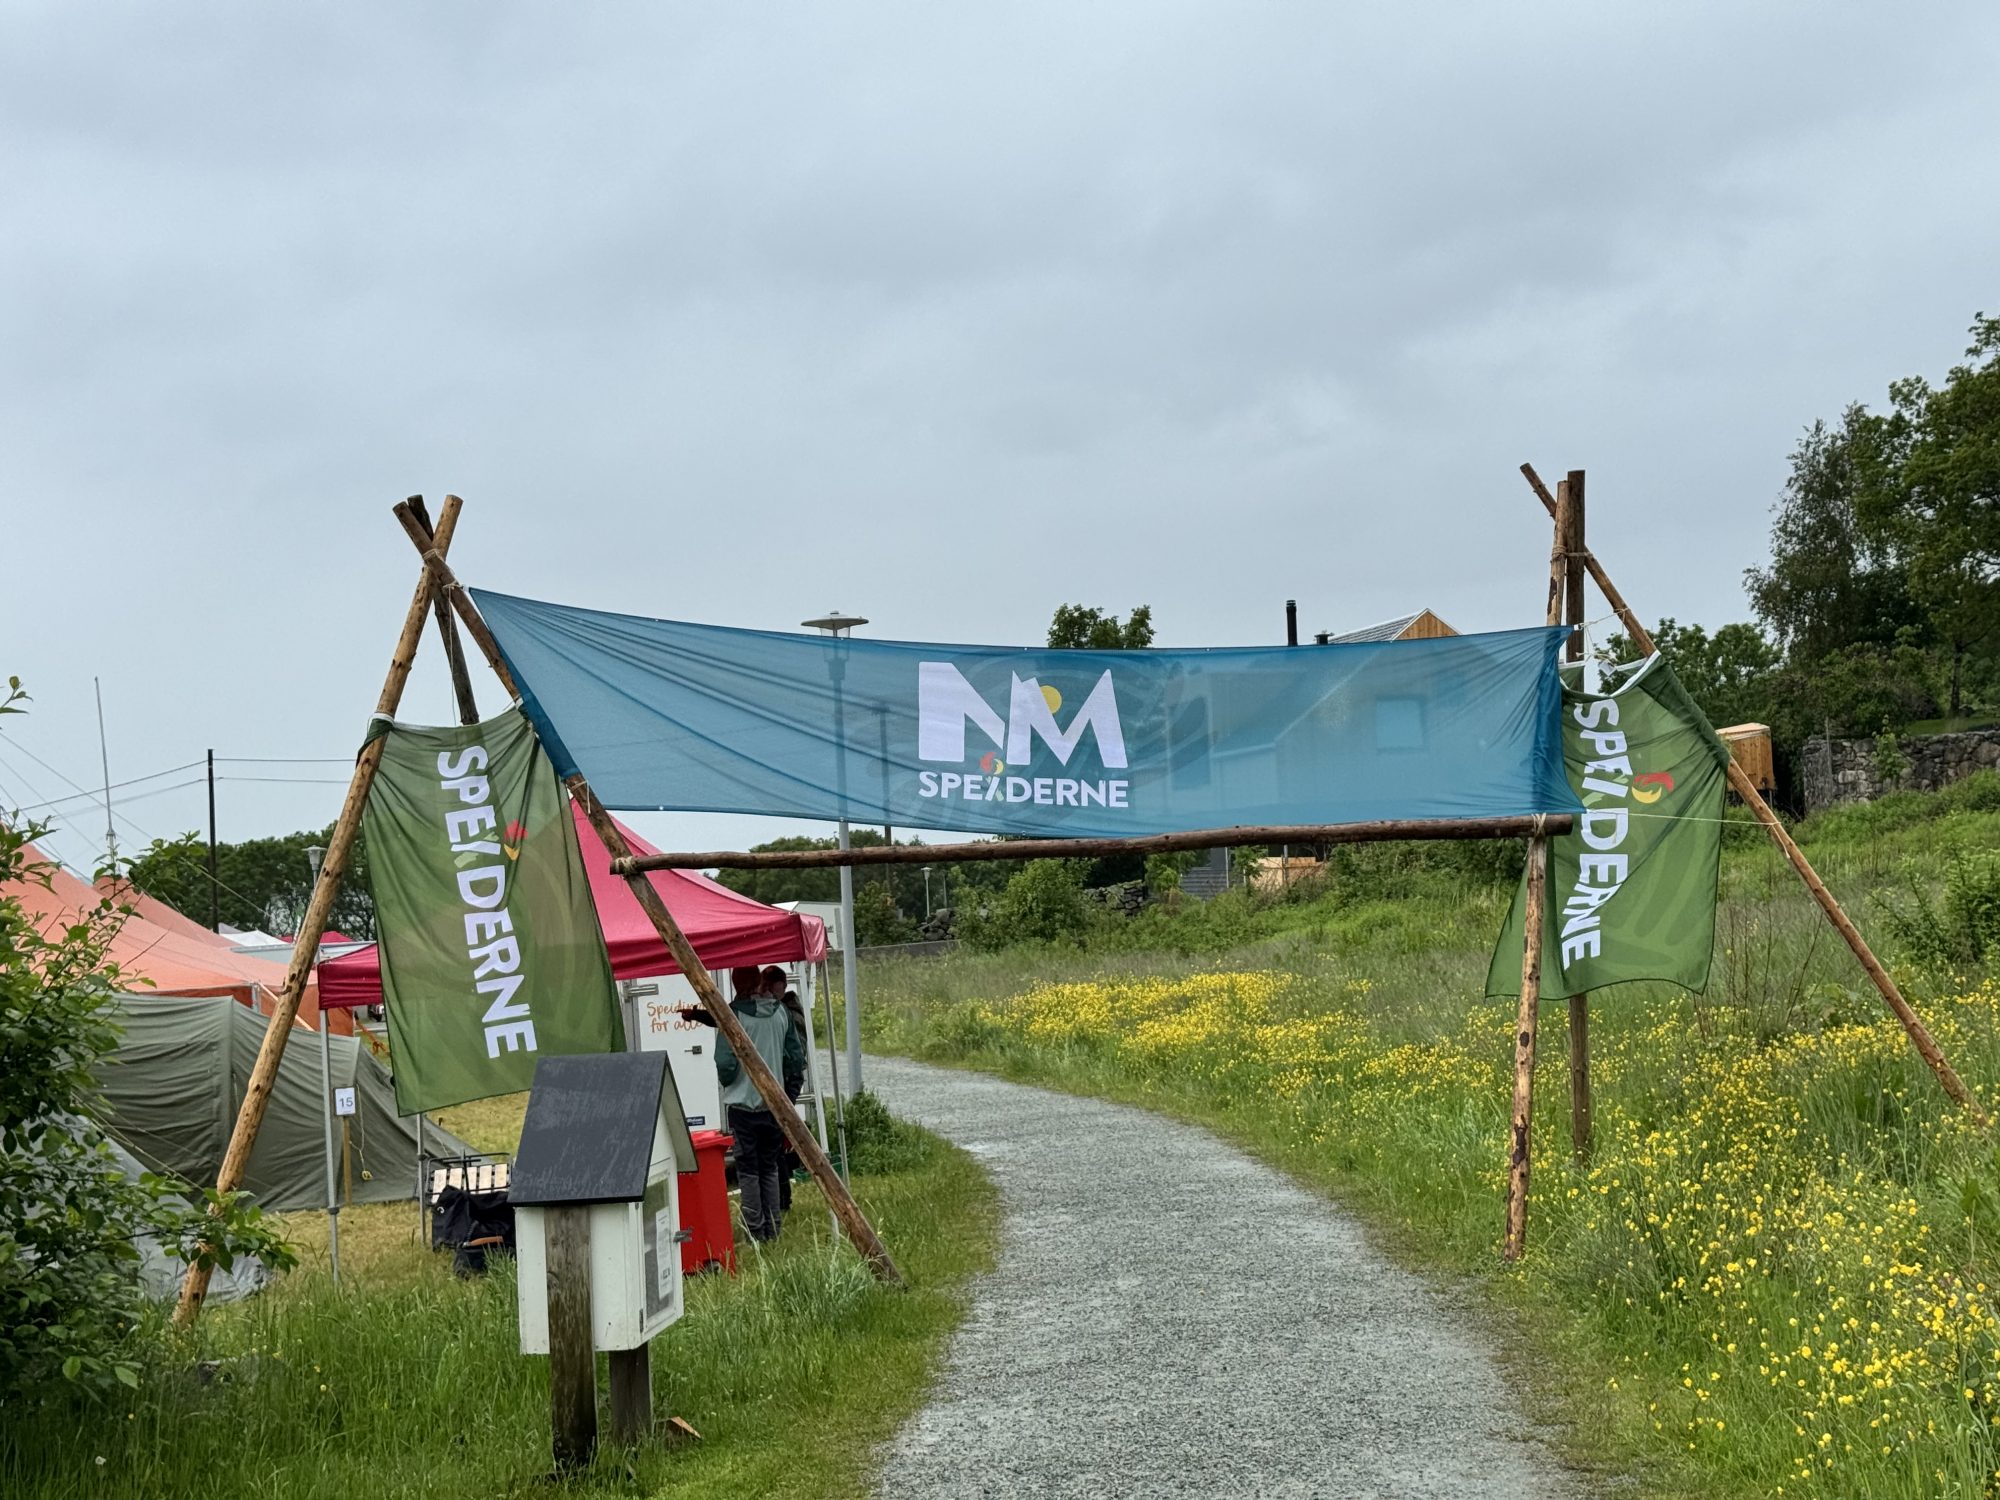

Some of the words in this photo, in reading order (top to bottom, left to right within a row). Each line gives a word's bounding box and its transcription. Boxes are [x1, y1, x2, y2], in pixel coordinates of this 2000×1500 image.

[919, 661, 1128, 768] NM
[918, 771, 1129, 808] SPEIDERNE
[1560, 698, 1633, 970] SPEIDERNE
[437, 745, 538, 1059] SPEIDERNE
[650, 1018, 669, 1033] for
[339, 1097, 354, 1108] 15
